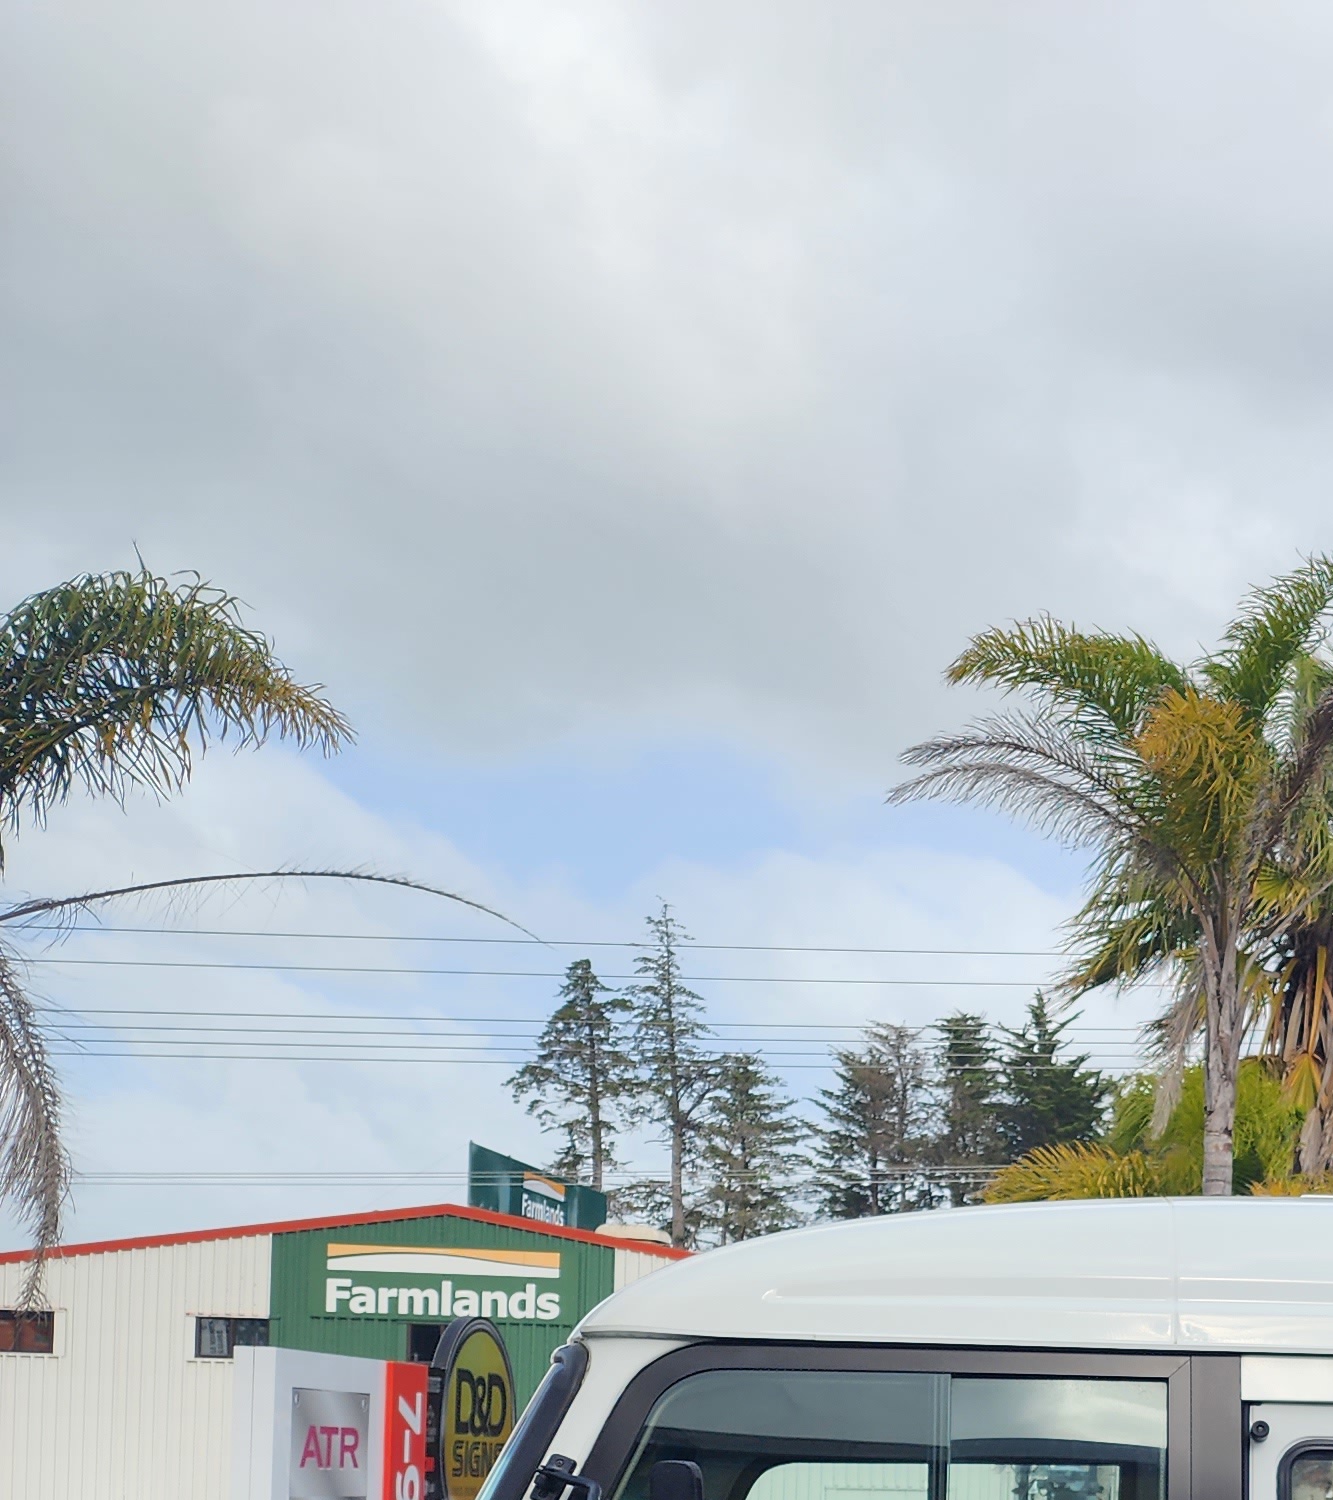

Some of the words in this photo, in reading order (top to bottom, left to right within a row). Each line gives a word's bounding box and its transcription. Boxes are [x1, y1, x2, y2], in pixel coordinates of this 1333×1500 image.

[521, 1193, 565, 1226] Farmlands
[325, 1278, 560, 1320] Farmlands
[455, 1367, 507, 1437] D&D
[299, 1424, 359, 1469] ATR
